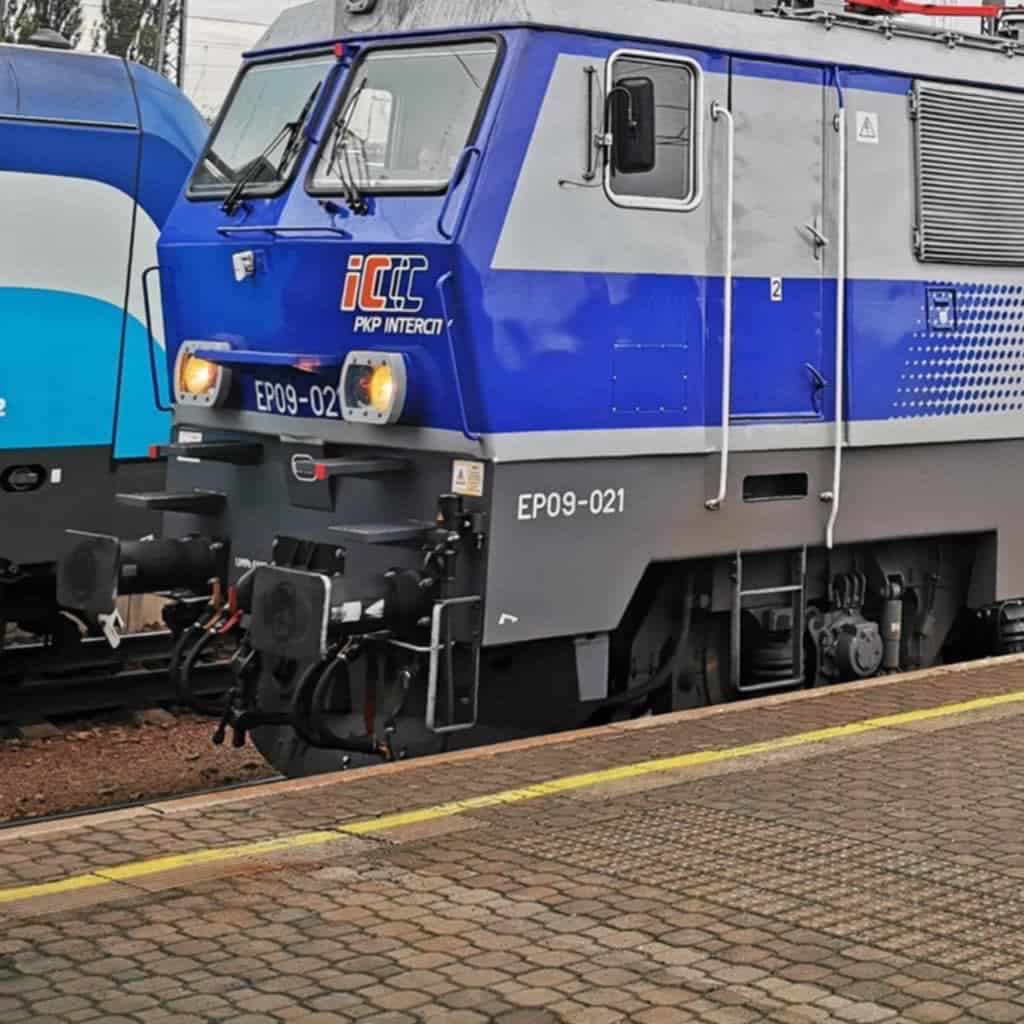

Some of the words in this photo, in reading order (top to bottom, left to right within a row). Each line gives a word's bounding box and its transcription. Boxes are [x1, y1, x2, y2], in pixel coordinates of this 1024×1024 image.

[772, 280, 781, 297] 2
[353, 316, 382, 333] PKP
[255, 379, 341, 417] EP09-02
[517, 487, 625, 520] EP09-021
